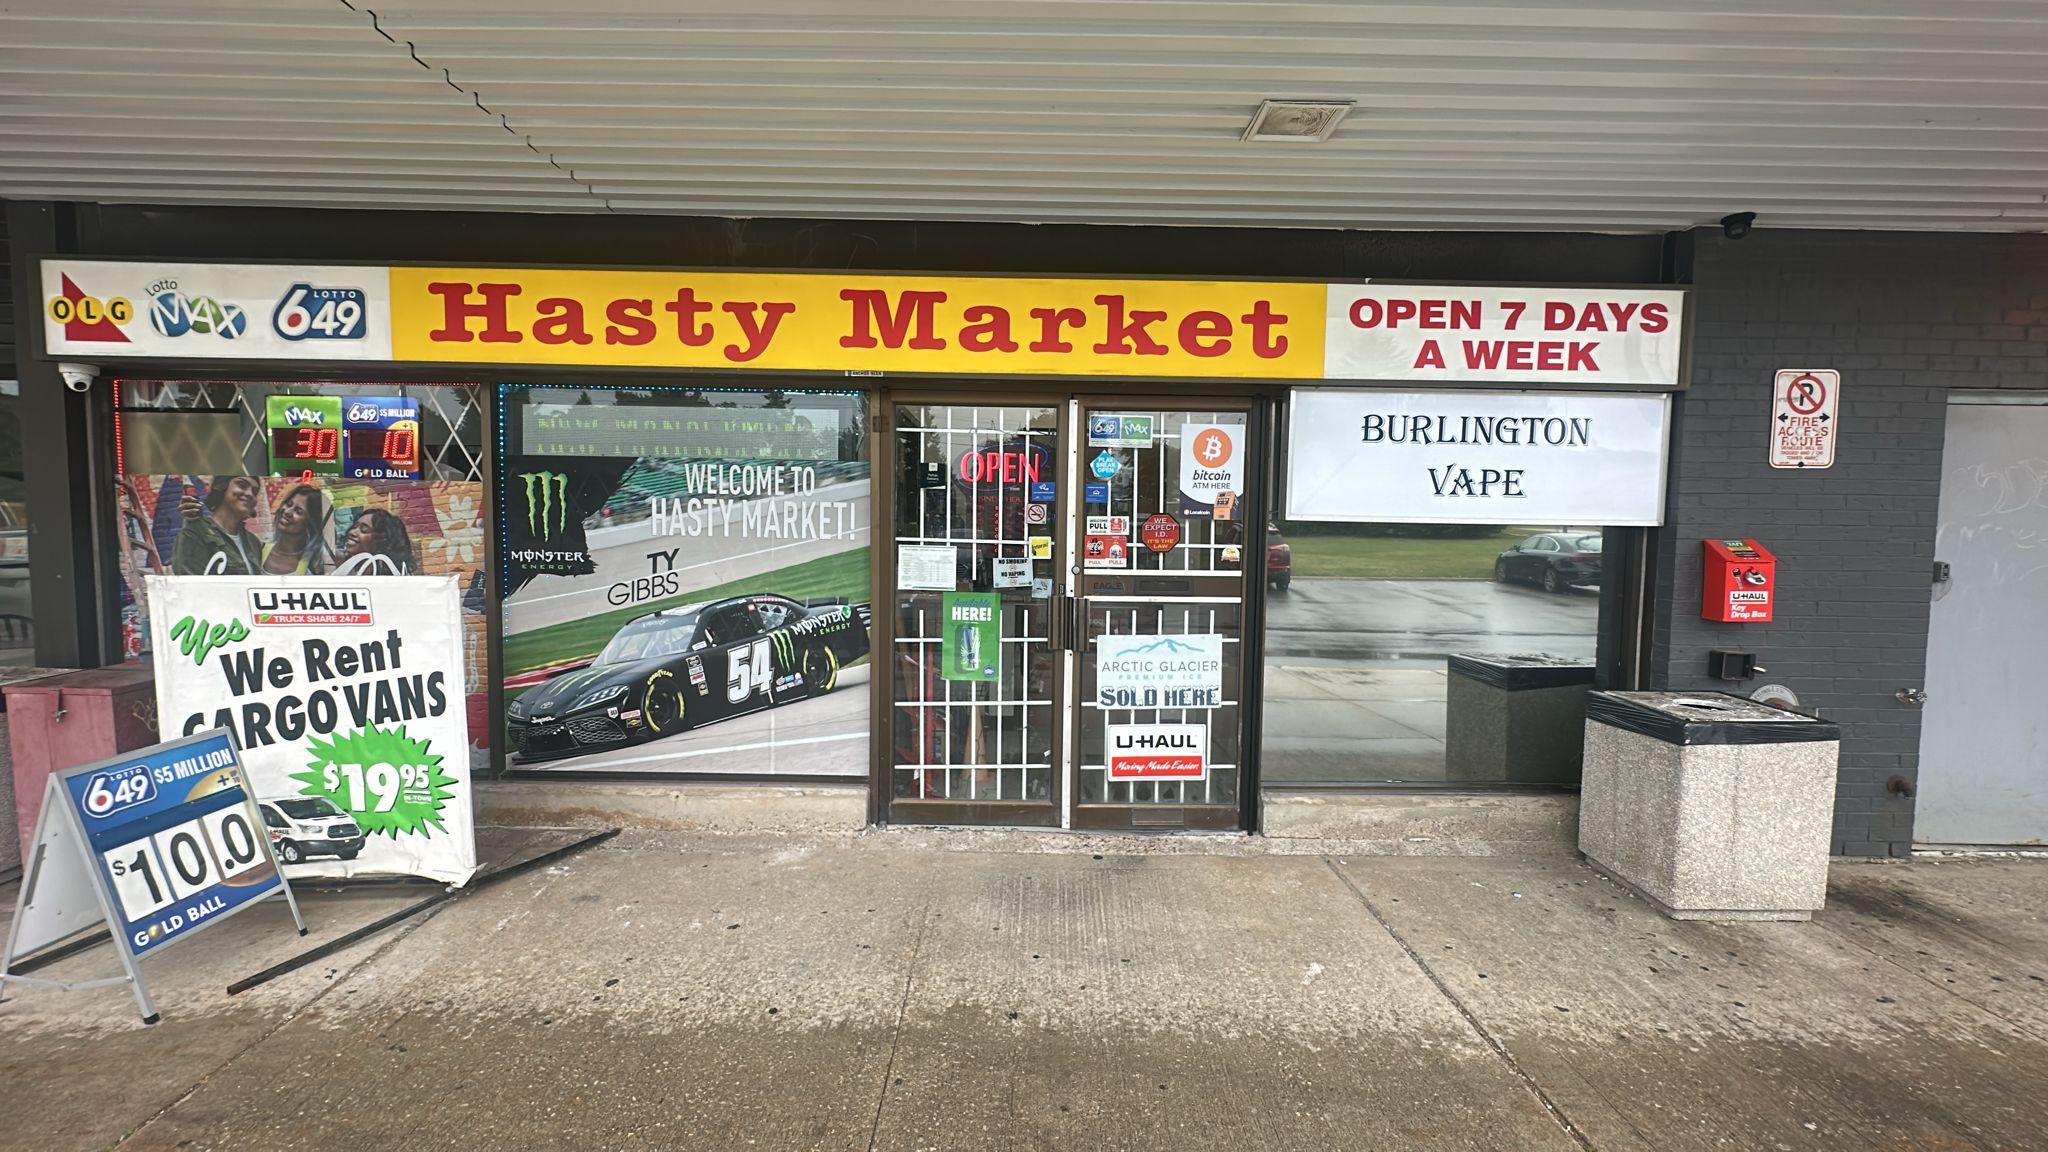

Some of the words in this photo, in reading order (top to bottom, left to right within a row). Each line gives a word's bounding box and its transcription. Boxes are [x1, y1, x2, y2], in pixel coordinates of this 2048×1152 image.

[146, 279, 178, 297] Lotto
[313, 291, 357, 299] LOTTO
[53, 299, 126, 321] OLG
[151, 292, 246, 338] MAX
[1349, 298, 1482, 329] OPEN
[1500, 301, 1527, 331] 7
[1544, 302, 1669, 333] DAYS
[427, 281, 797, 363] Hasty
[838, 288, 1289, 359] Market
[1413, 339, 1446, 369] A
[1462, 340, 1601, 371] WEEK
[285, 406, 324, 426] MAX
[388, 408, 415, 417] MILLION
[1790, 416, 1819, 427] FIRE
[1124, 423, 1149, 435] MAX
[1361, 413, 1593, 447] BURLINGTON
[296, 428, 338, 458] 30
[382, 430, 414, 459] 10
[1781, 437, 1823, 446] ROUTE
[386, 469, 409, 478] BALL
[960, 451, 1040, 484] OPEN
[1192, 470, 1231, 481] bitcoin
[684, 463, 785, 496] WELCOME
[785, 466, 815, 497] TO
[1427, 463, 1527, 497] VAPE
[651, 497, 734, 537] HASTY
[742, 500, 857, 541] MARKET!
[510, 549, 584, 564] MONSTER
[647, 548, 680, 574] TY
[607, 571, 680, 606] GIBBS
[253, 592, 368, 611] U-HAUL
[1731, 604, 1746, 613] Key
[273, 615, 305, 623] TRUCK
[306, 615, 338, 623] SHARE
[339, 614, 360, 622] 24/7
[790, 609, 844, 637] MONSTER
[952, 606, 992, 621] HERE!
[1730, 611, 1751, 619] Drop
[1751, 610, 1768, 618] Box
[819, 623, 851, 636] ENERGY
[170, 615, 251, 666] Yes
[219, 647, 294, 697] We
[302, 629, 403, 683] Rent
[726, 637, 775, 704] 54
[1102, 661, 1153, 672] ARCTIC
[1159, 660, 1218, 672] GLACIER
[342, 671, 447, 728] VANS
[1100, 686, 1158, 706] SOLD
[1164, 685, 1220, 706] HERE
[1116, 735, 1197, 748] U-HAUL
[110, 768, 142, 782] LOTTO
[154, 765, 174, 784] $5
[175, 748, 234, 780] MILLION
[1115, 760, 1145, 773] Moving
[1145, 760, 1171, 770] Made
[186, 895, 227, 923] BALL
